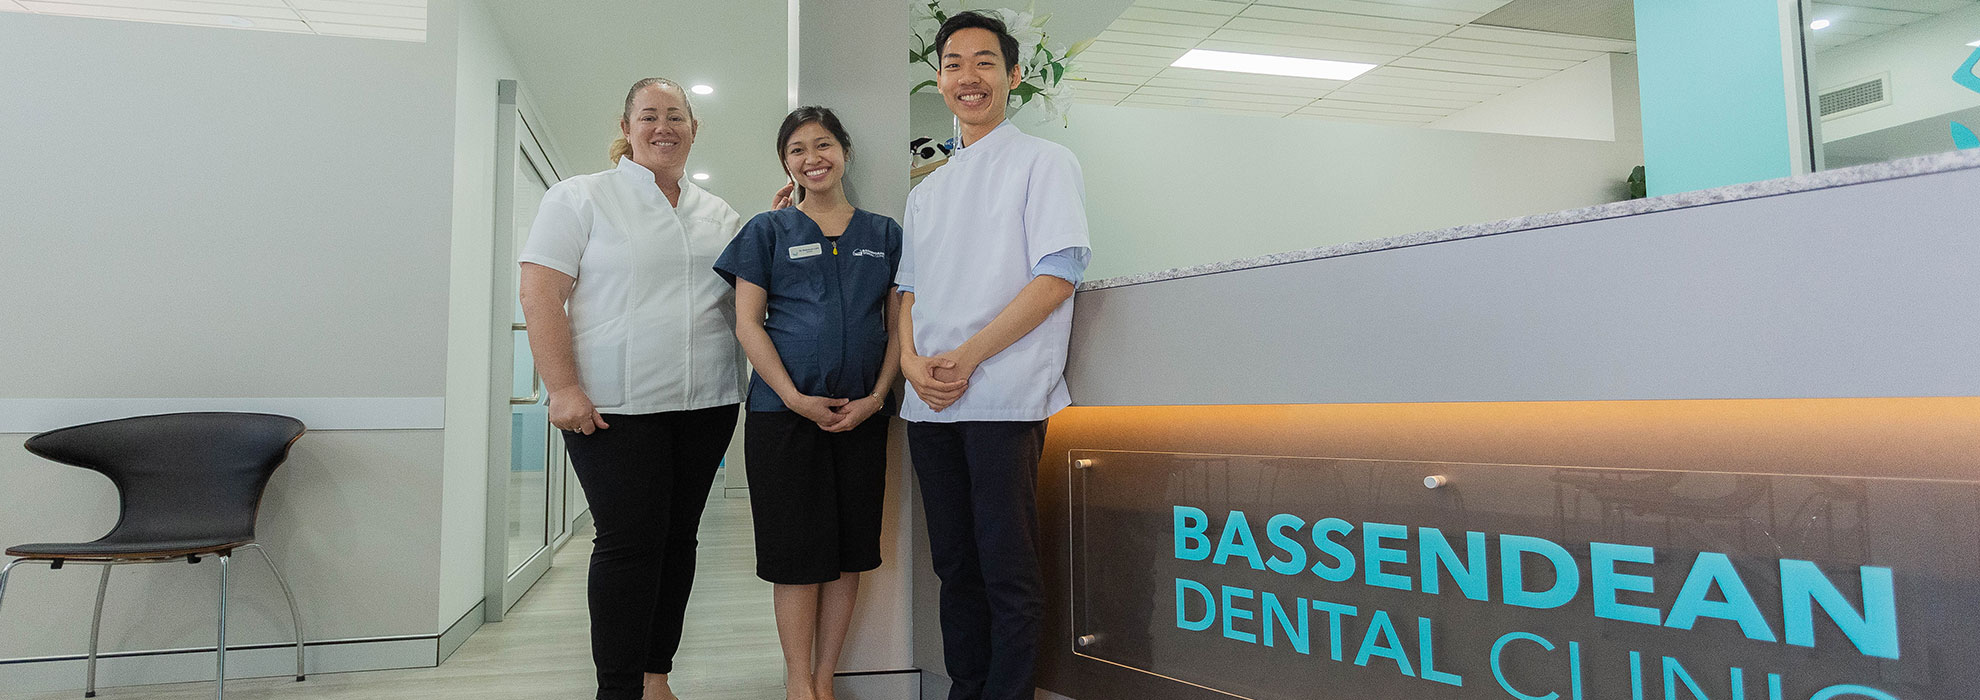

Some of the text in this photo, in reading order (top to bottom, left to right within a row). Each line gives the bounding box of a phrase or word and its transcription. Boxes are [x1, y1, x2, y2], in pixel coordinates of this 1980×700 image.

[1173, 505, 1900, 661] BASSENDEAN
[1175, 577, 1900, 700] DENTAL CLIN
